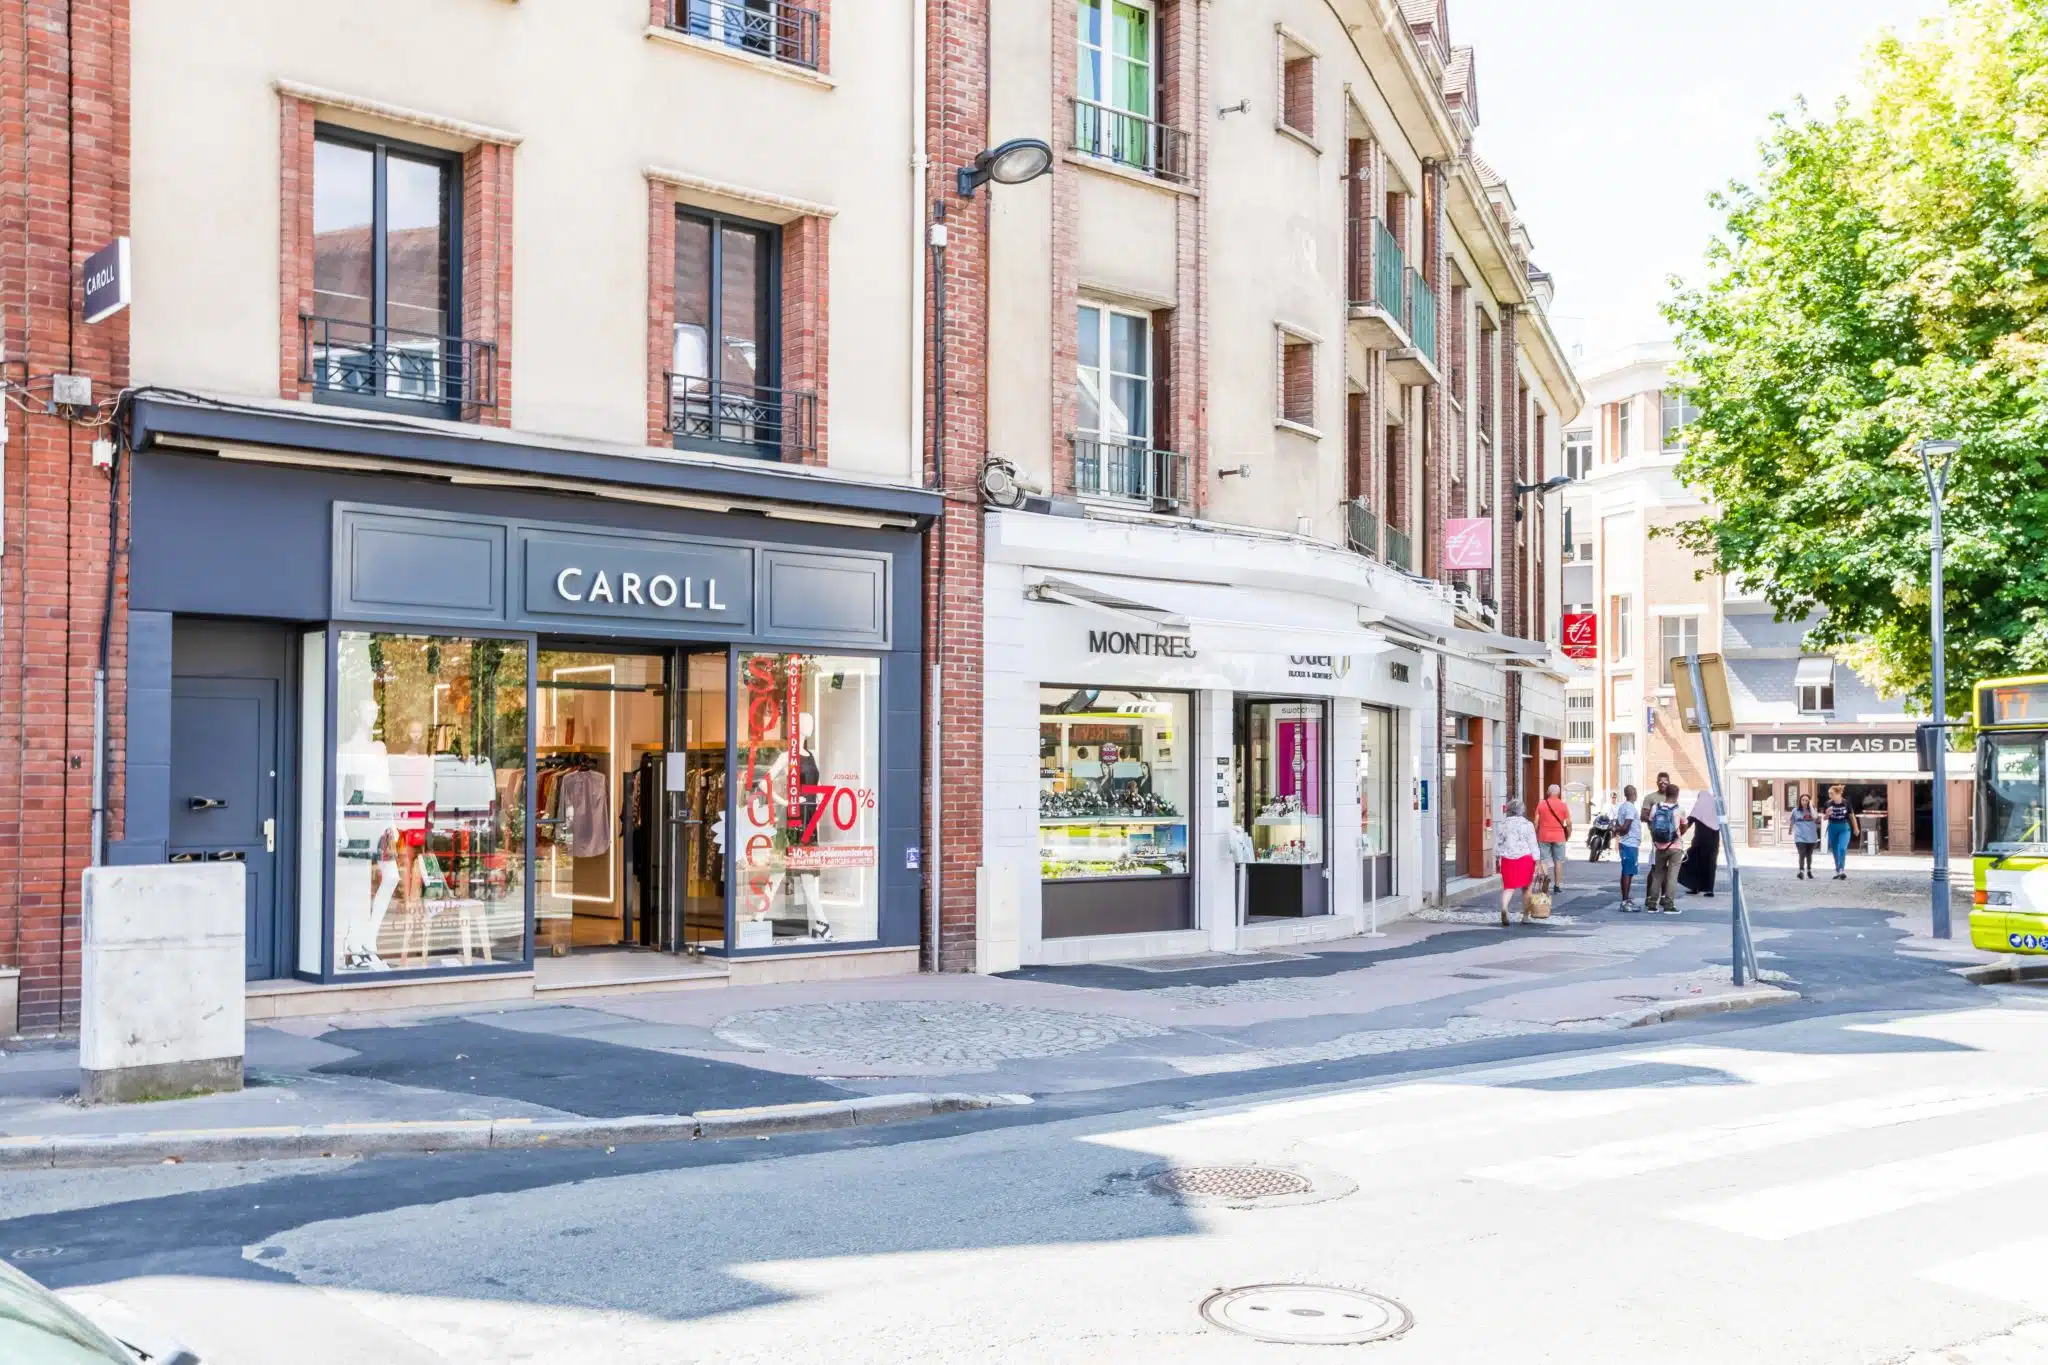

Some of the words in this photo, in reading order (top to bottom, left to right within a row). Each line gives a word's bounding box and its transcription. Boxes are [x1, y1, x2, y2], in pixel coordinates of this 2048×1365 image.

[86, 264, 115, 296] CAROLL
[557, 567, 727, 610] CAROLL
[1088, 630, 1197, 659] MONTRES
[789, 656, 798, 735] NOUVELLE
[1772, 737, 1801, 753] LE
[1805, 737, 1884, 753] RELAIS
[1888, 738, 1917, 753] DE
